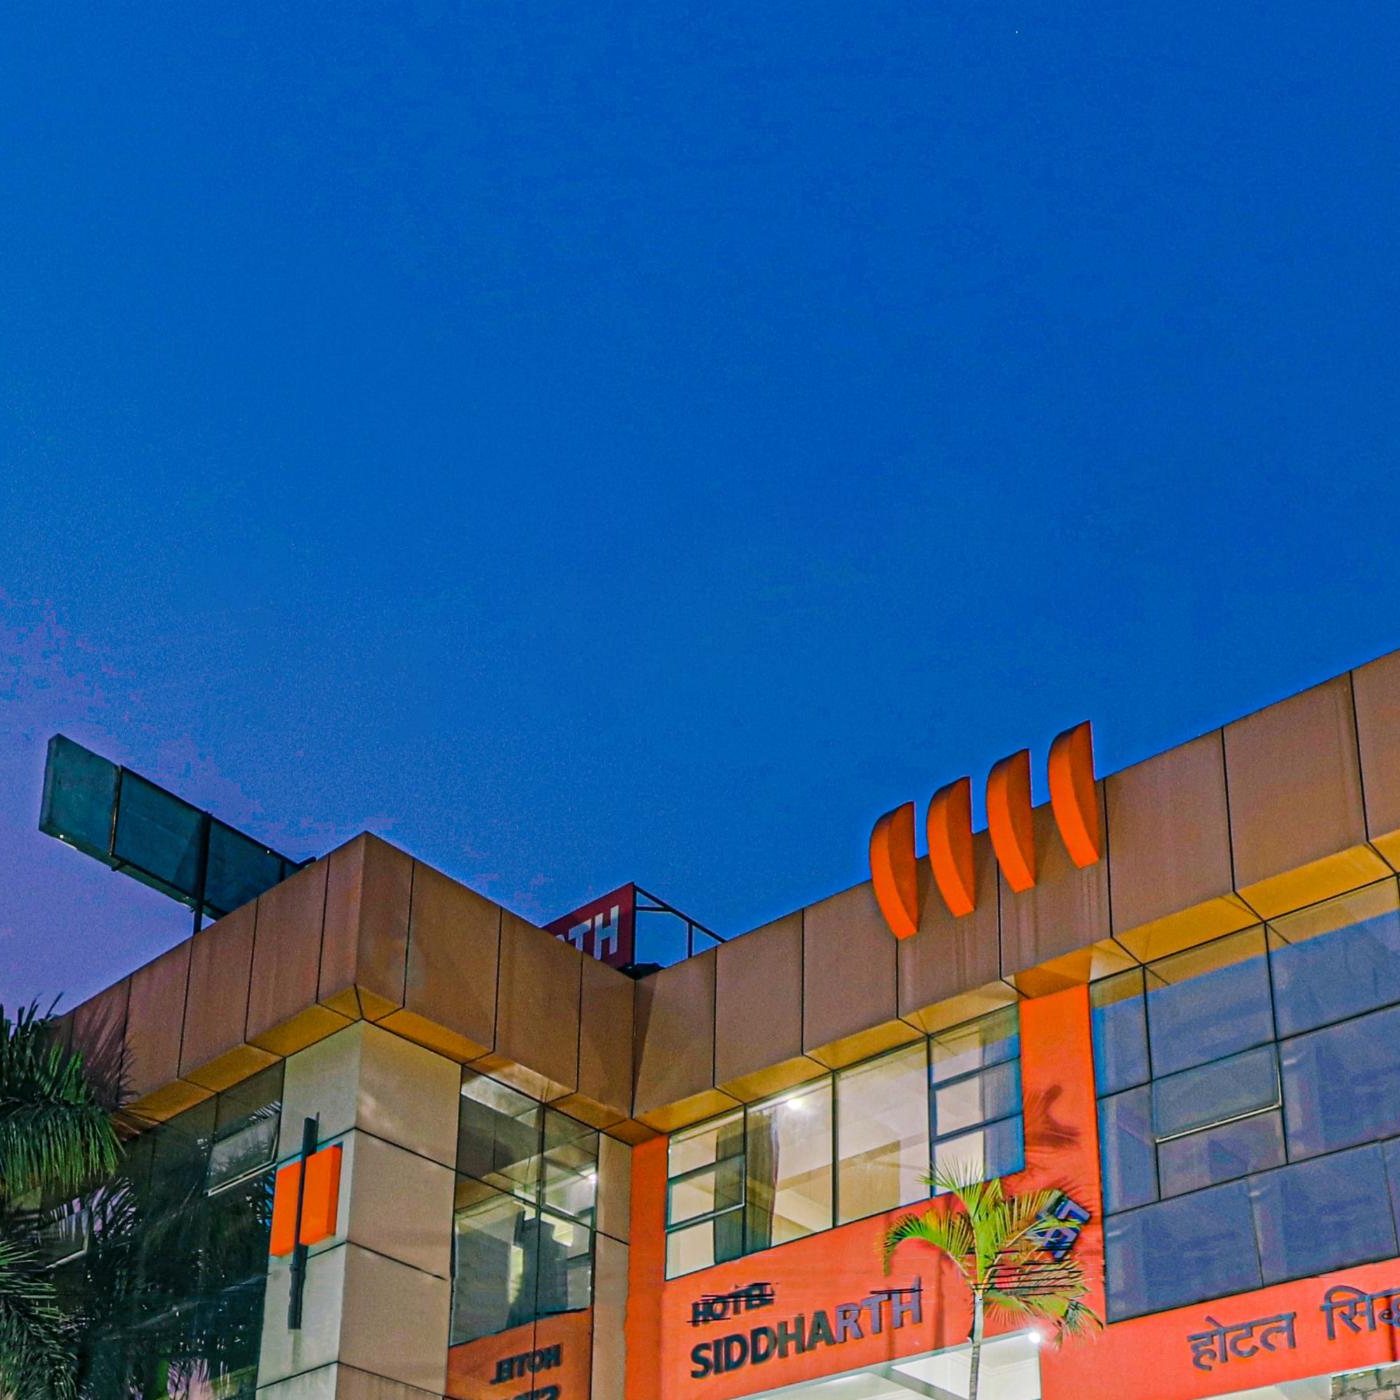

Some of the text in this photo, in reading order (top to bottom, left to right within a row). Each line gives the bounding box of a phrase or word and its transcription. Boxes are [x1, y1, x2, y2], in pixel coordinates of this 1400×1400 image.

[556, 905, 619, 961] TH
[690, 1282, 776, 1327] HOTEL
[690, 1276, 923, 1380] SIDDHARTH
[1187, 1311, 1297, 1372] होटल
